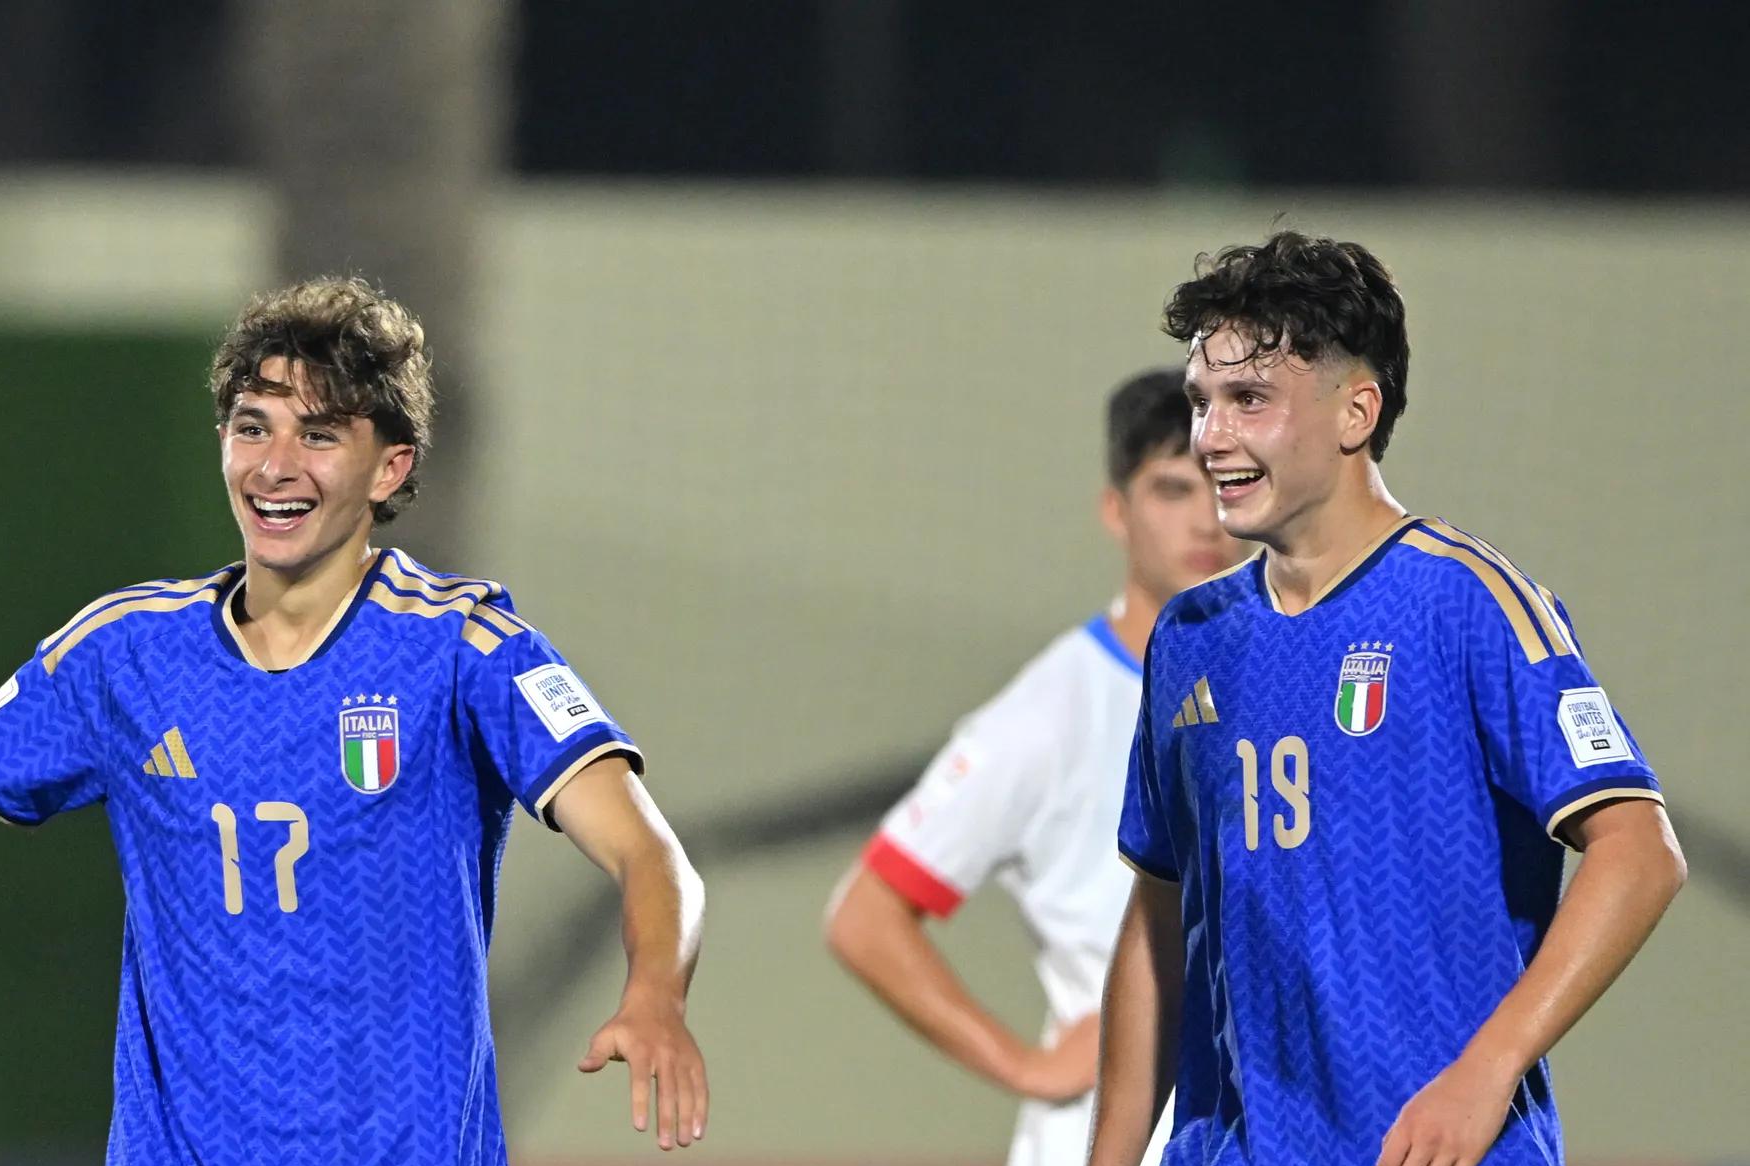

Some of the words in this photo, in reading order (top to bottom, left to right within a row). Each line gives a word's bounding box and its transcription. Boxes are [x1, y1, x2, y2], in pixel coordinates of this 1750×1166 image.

[1344, 660, 1385, 675] ITALIA
[542, 682, 575, 702] UNITE
[344, 715, 393, 732] ITALIA
[1571, 711, 1605, 727] UNITES
[1236, 735, 1310, 851] 19
[211, 802, 309, 915] 17
